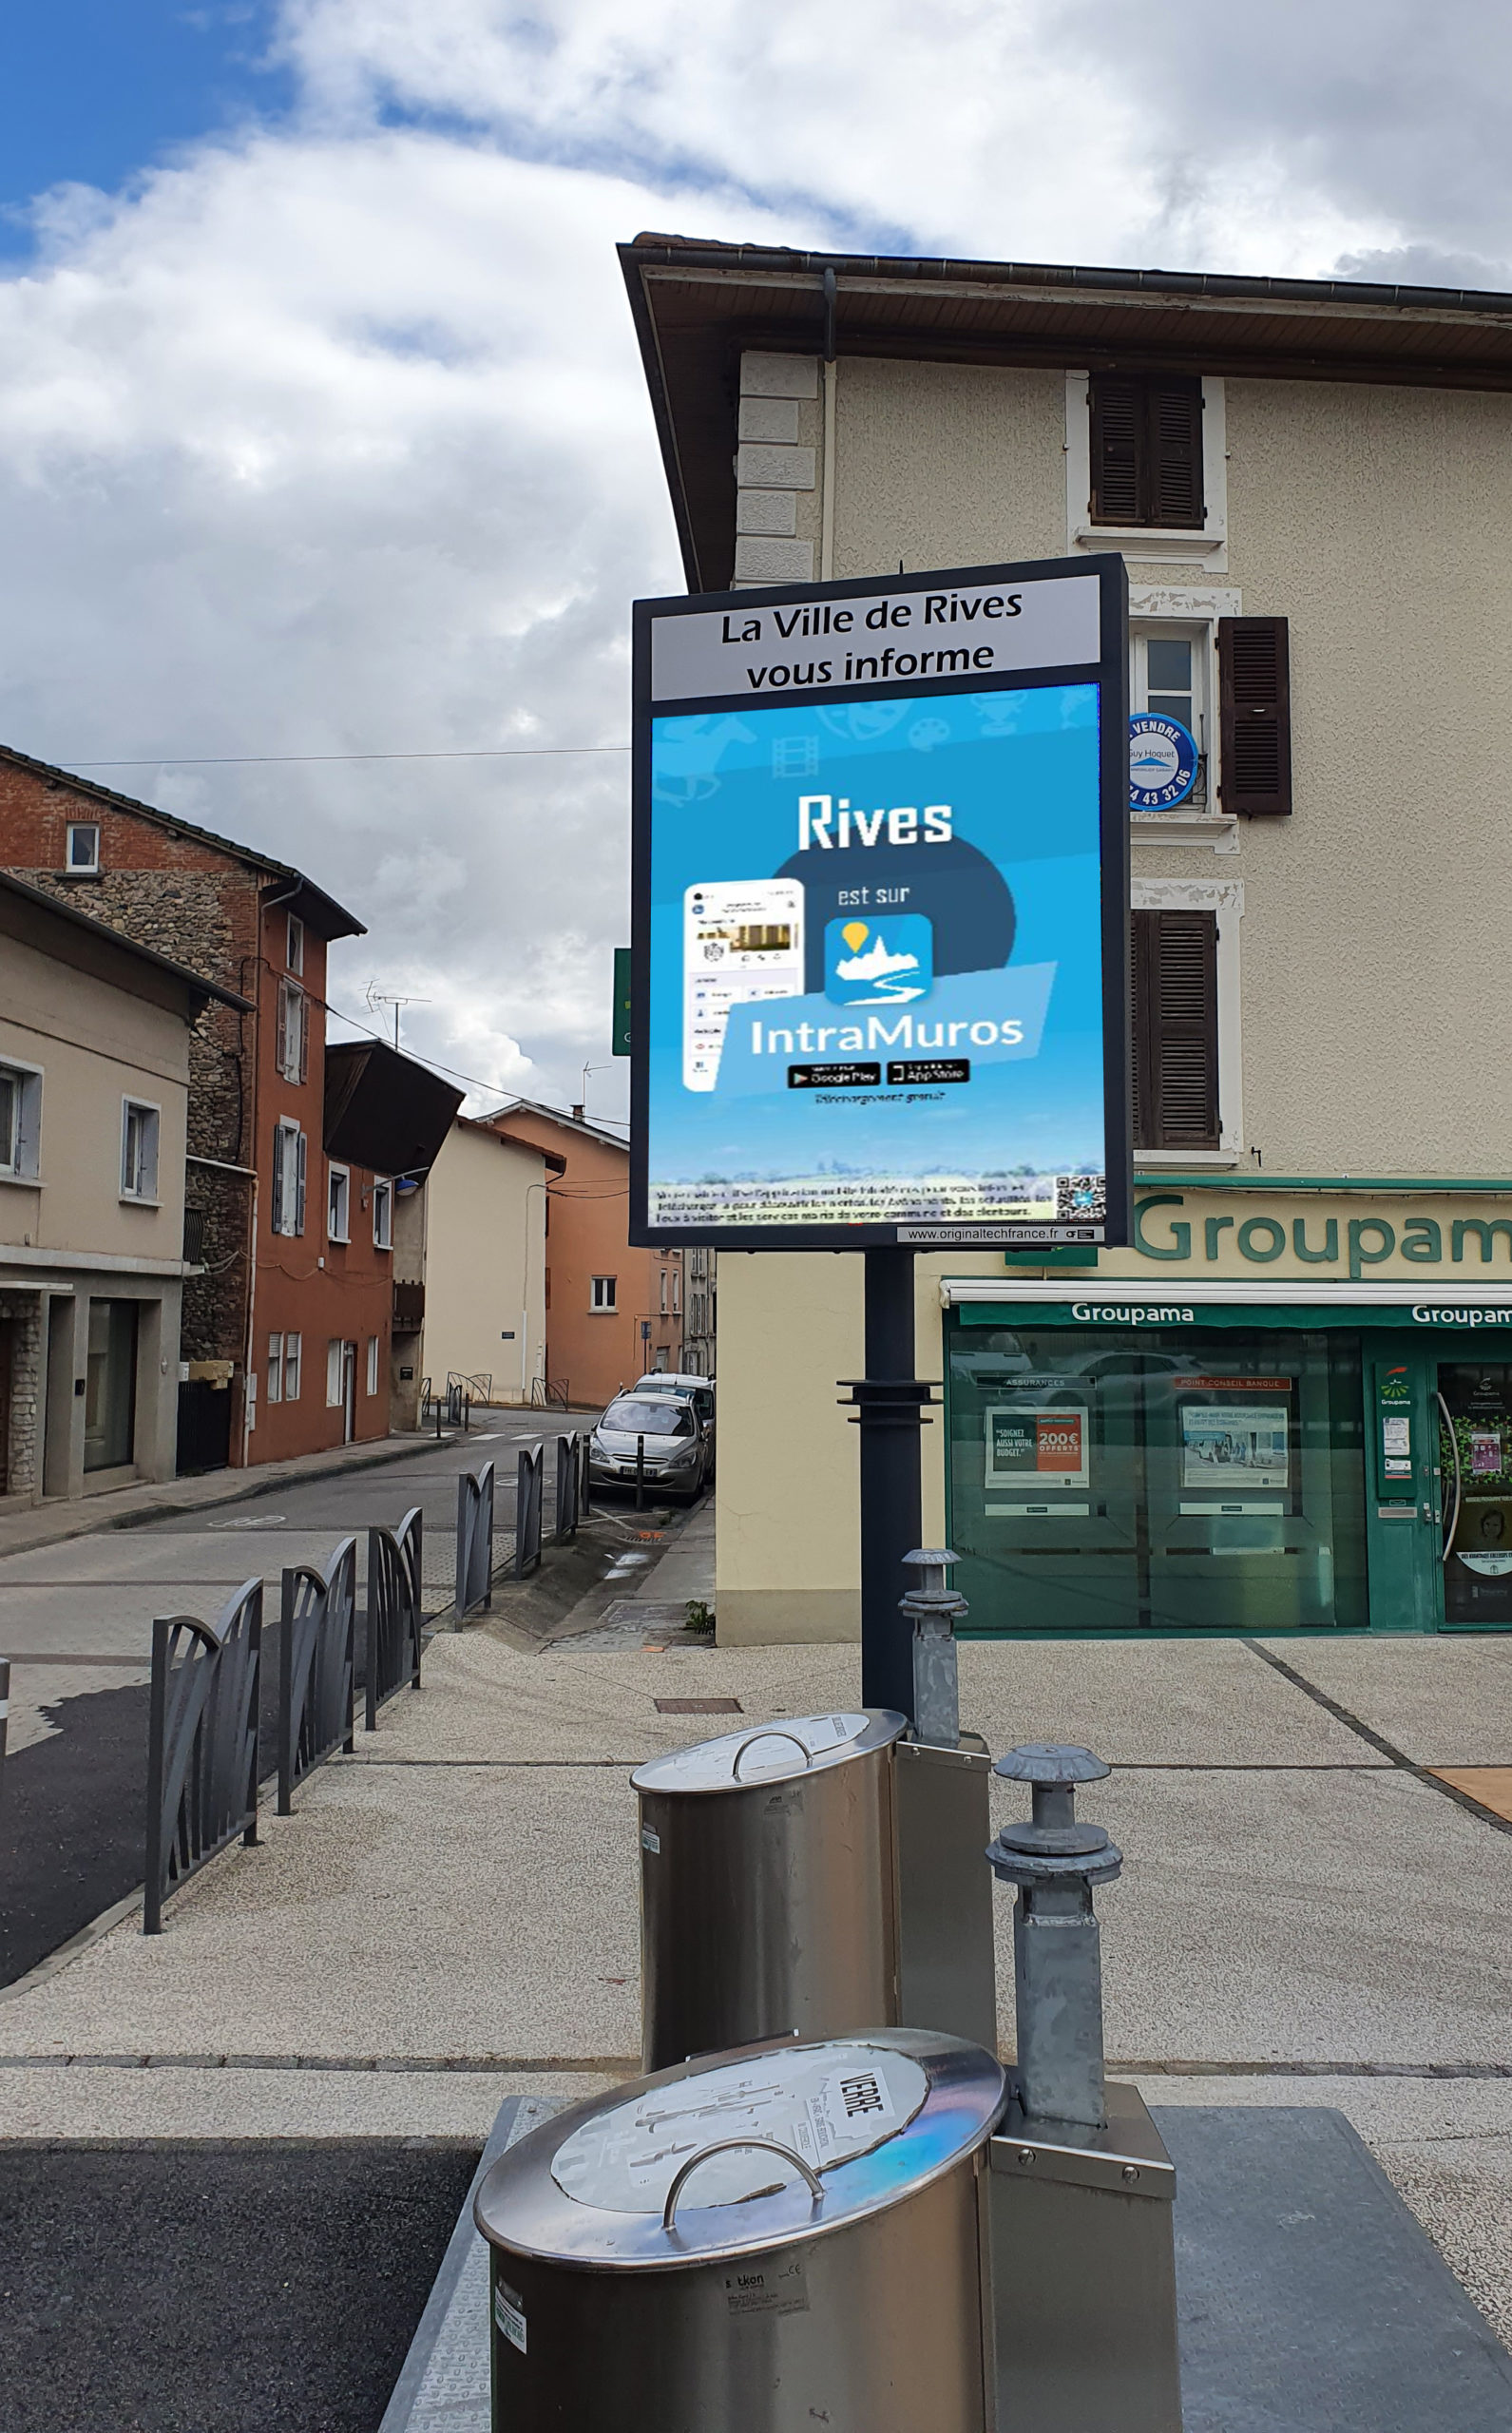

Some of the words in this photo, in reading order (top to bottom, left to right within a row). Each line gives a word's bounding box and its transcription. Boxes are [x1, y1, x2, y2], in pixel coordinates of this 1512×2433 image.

[721, 616, 762, 643] La
[773, 606, 854, 638] Ville
[866, 601, 912, 631] de
[924, 593, 1023, 624] Rives
[746, 661, 833, 689] vous
[845, 645, 995, 680] informe
[1132, 720, 1181, 742] VENDRE
[1144, 749, 1176, 758] Hoquet
[1129, 785, 1139, 801] 4
[1142, 792, 1158, 805] 43
[1161, 785, 1178, 801] 32
[1176, 769, 1191, 787] 06
[798, 795, 952, 851] Rives
[838, 886, 870, 906] est
[875, 888, 910, 904] sur
[752, 1015, 1024, 1055] IntraMuros
[811, 1073, 850, 1083] Google
[852, 1072, 876, 1082] Play
[908, 1071, 932, 1082] App
[933, 1069, 965, 1080] Store
[908, 1228, 1059, 1241] www.originaltechfrance.fr
[1134, 1194, 1512, 1279] Groupam
[1071, 1302, 1195, 1326] Groupama
[1412, 1304, 1512, 1328] Groupam
[996, 1439, 1014, 1447] AUSSI
[1014, 1438, 1033, 1447] VOTRE
[1039, 1432, 1079, 1446] 200€
[839, 2072, 884, 2117] VERRE
